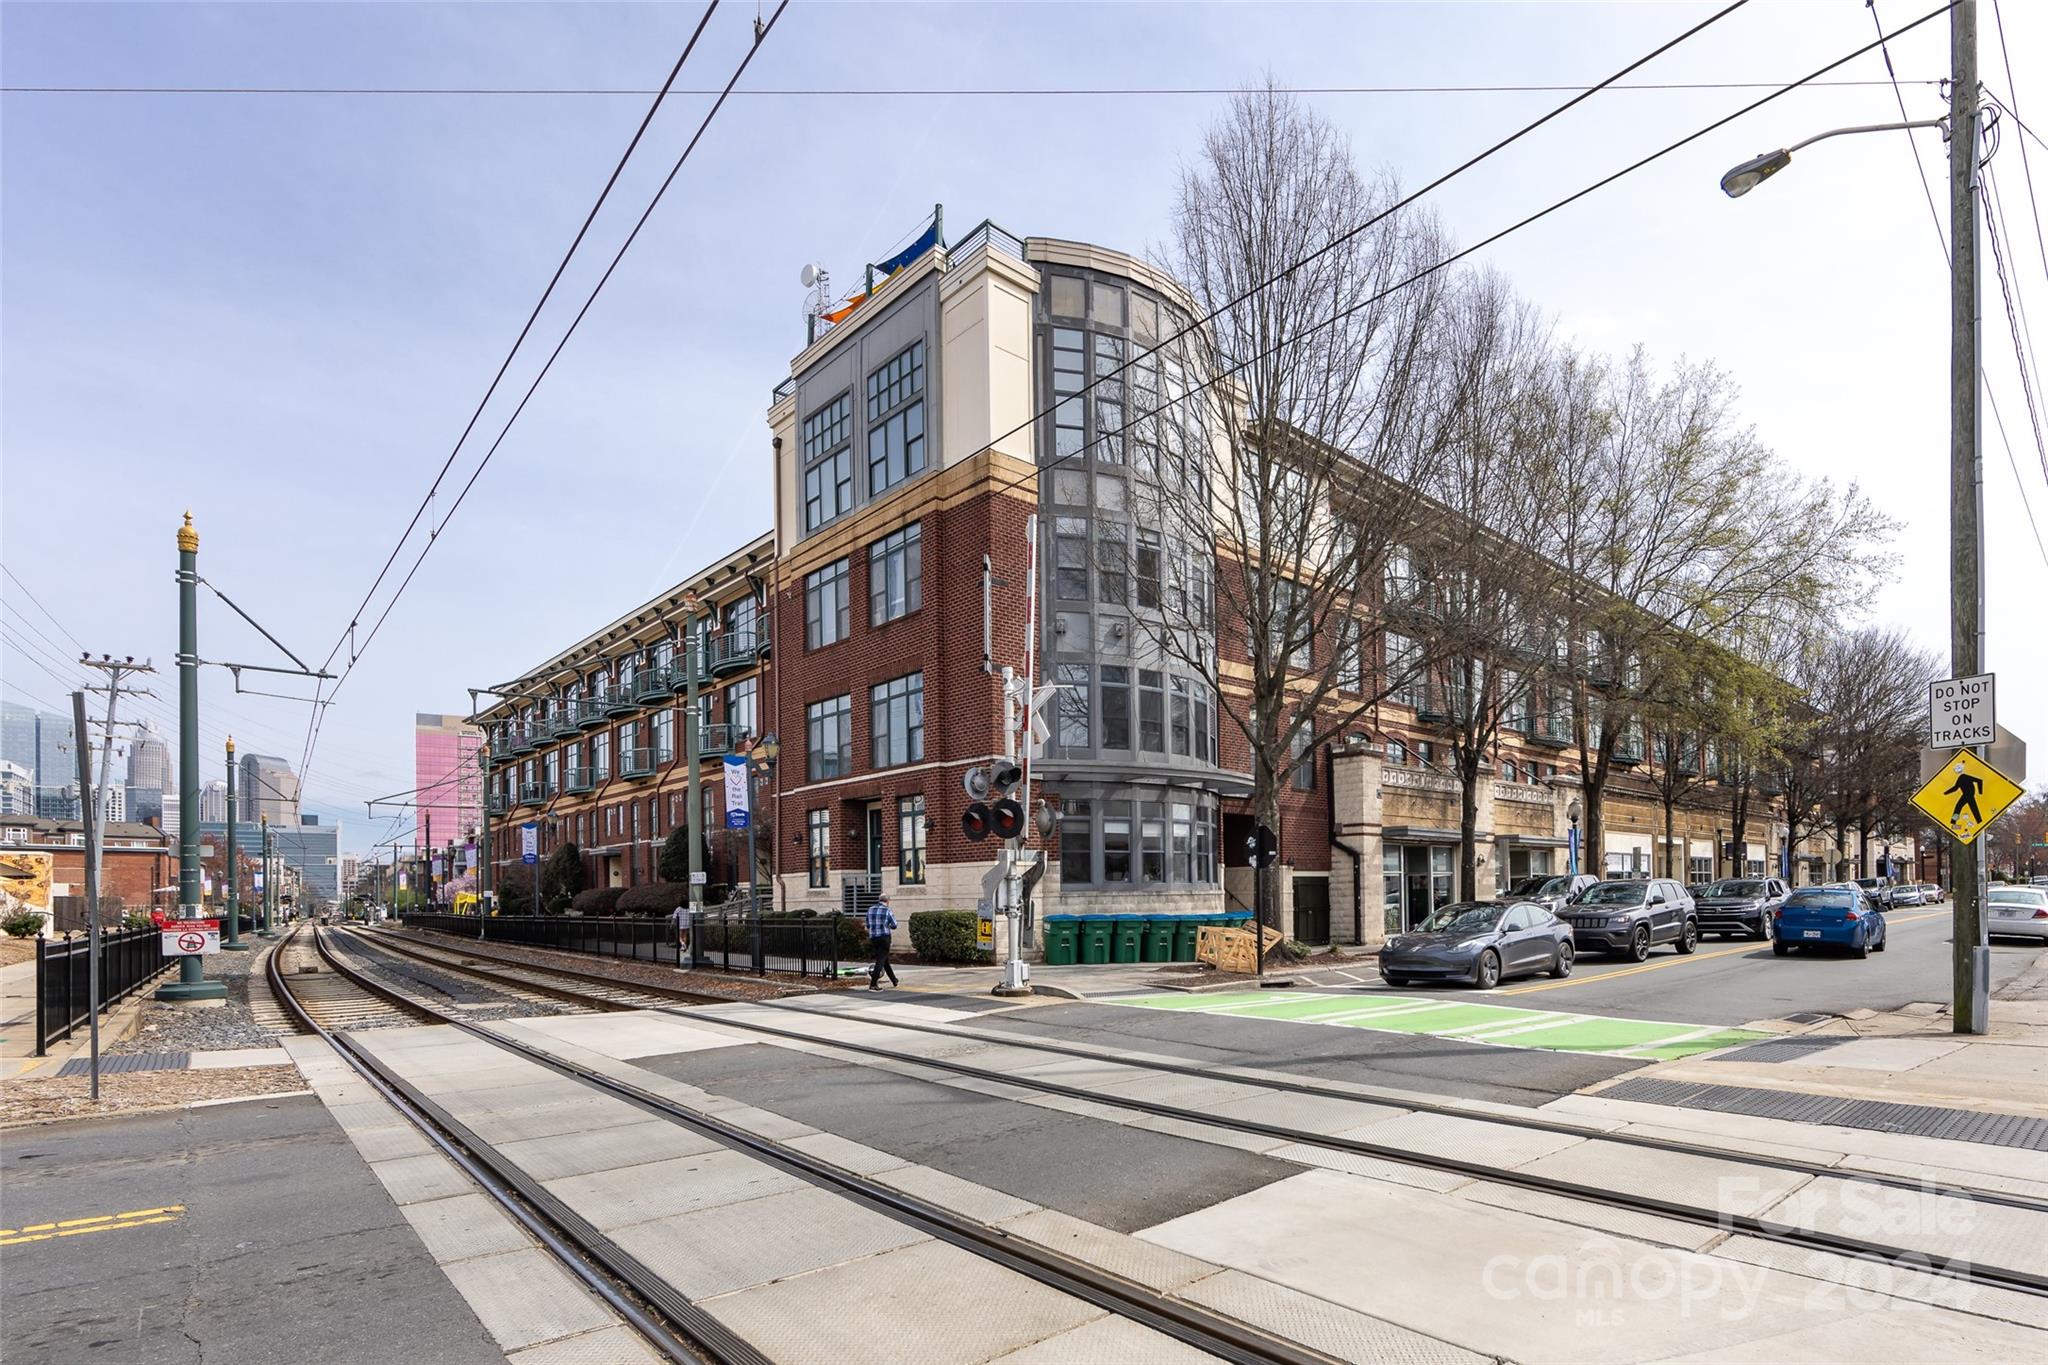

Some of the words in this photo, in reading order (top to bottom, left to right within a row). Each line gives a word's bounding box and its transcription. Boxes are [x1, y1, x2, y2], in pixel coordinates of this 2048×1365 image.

[1936, 687, 1954, 699] DO
[1961, 681, 1989, 695] NOT
[1944, 698, 1980, 712] STOP
[1952, 713, 1972, 725] ON
[1934, 726, 1990, 741] TRACKS
